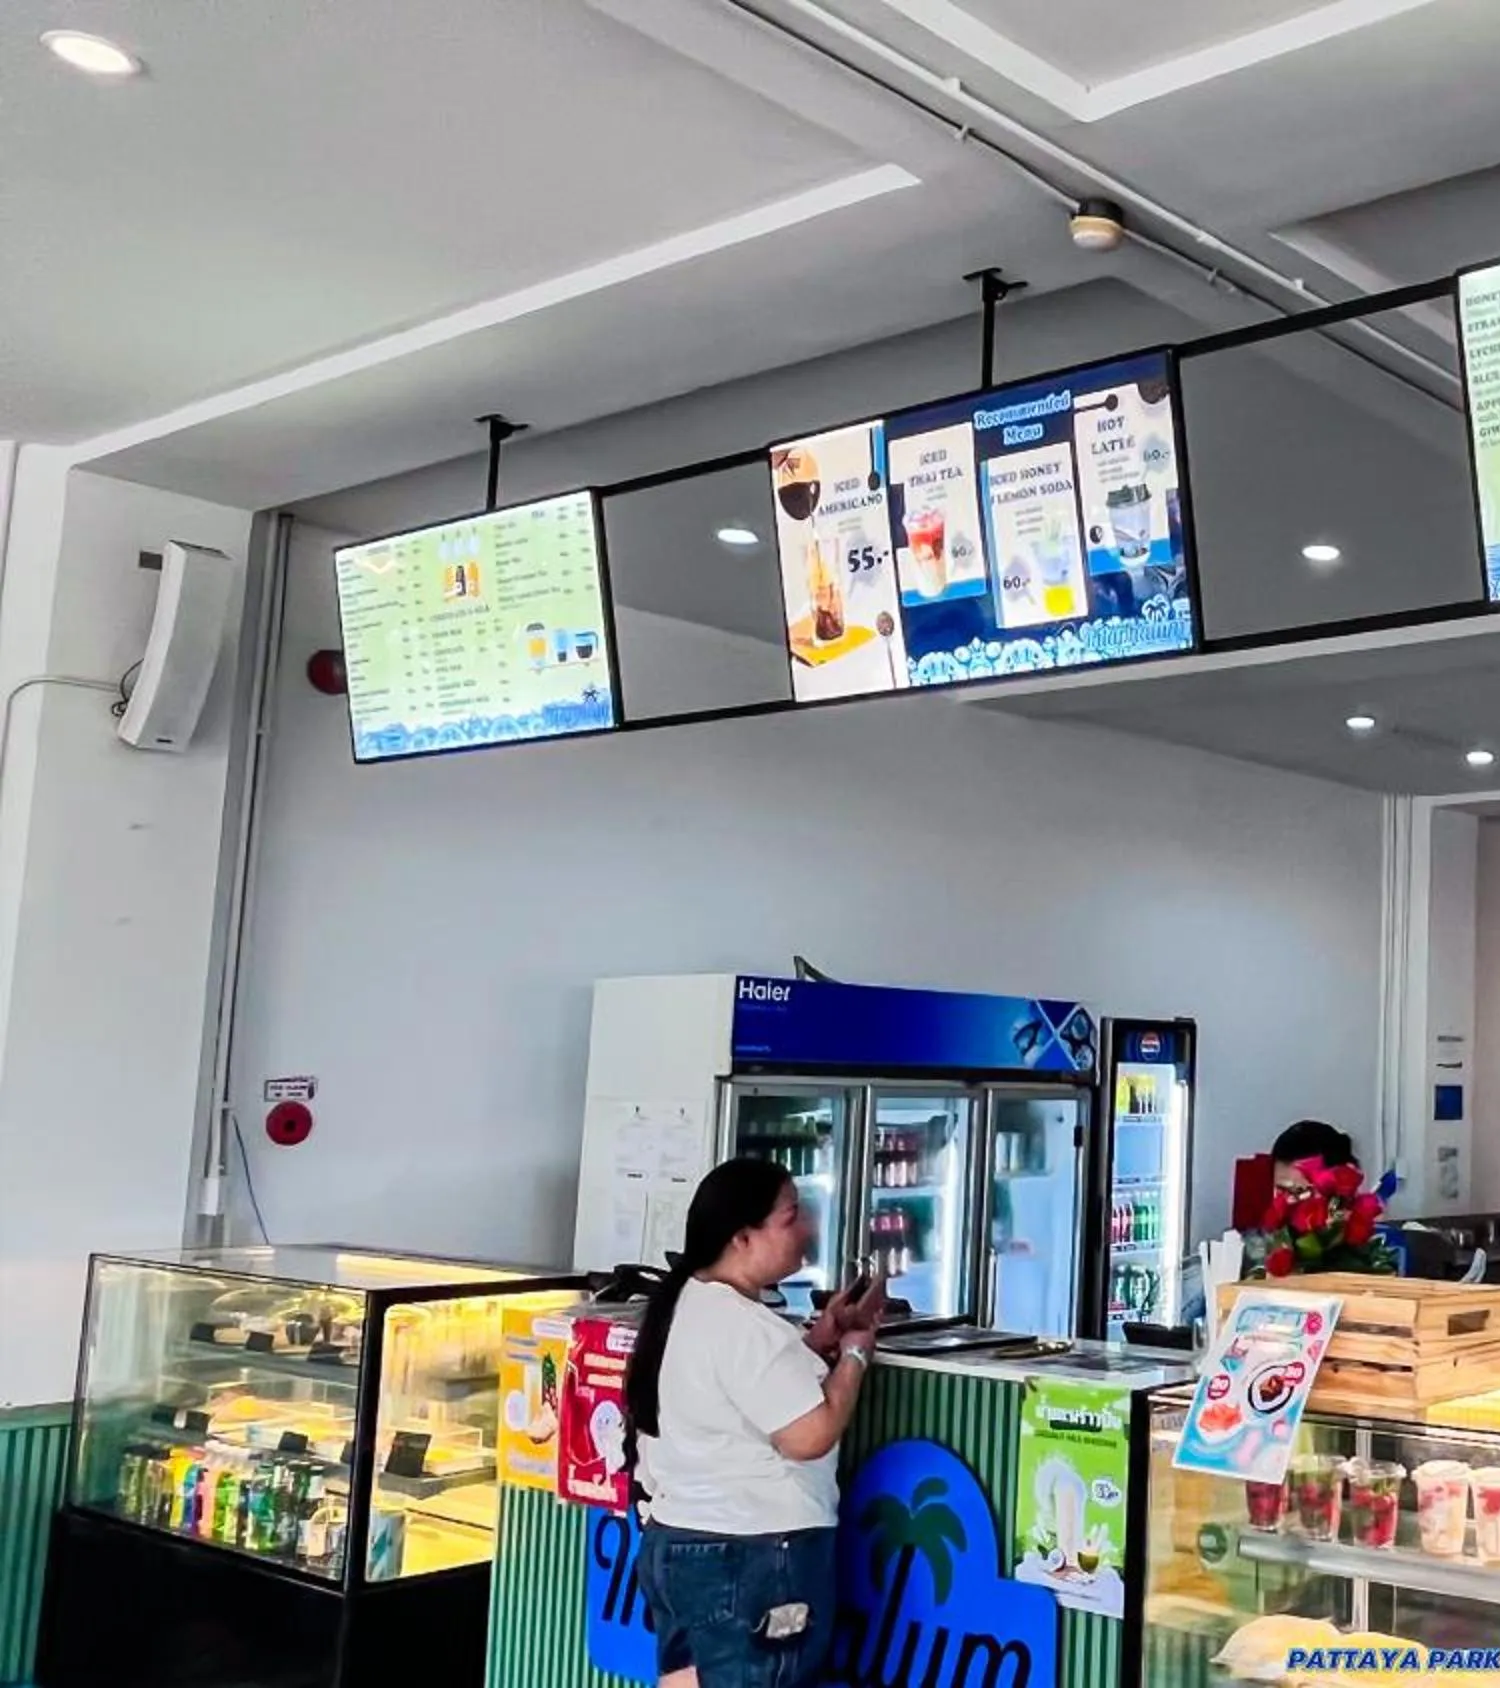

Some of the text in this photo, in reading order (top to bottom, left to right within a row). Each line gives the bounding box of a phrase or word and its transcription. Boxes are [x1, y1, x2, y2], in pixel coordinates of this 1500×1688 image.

[975, 390, 1070, 429] Recommended
[1003, 423, 1043, 445] Menu
[1097, 415, 1125, 433] HOT
[1091, 435, 1136, 455] LATTE
[920, 449, 947, 465] ICED
[908, 466, 963, 488] THAI TEA
[990, 462, 1061, 486] ICED HONEY
[834, 478, 861, 493] ICED
[997, 480, 1073, 504] LEMON SODA
[819, 493, 883, 516] AMERICANO
[848, 546, 889, 573] 55.-
[739, 979, 791, 1002] Haier
